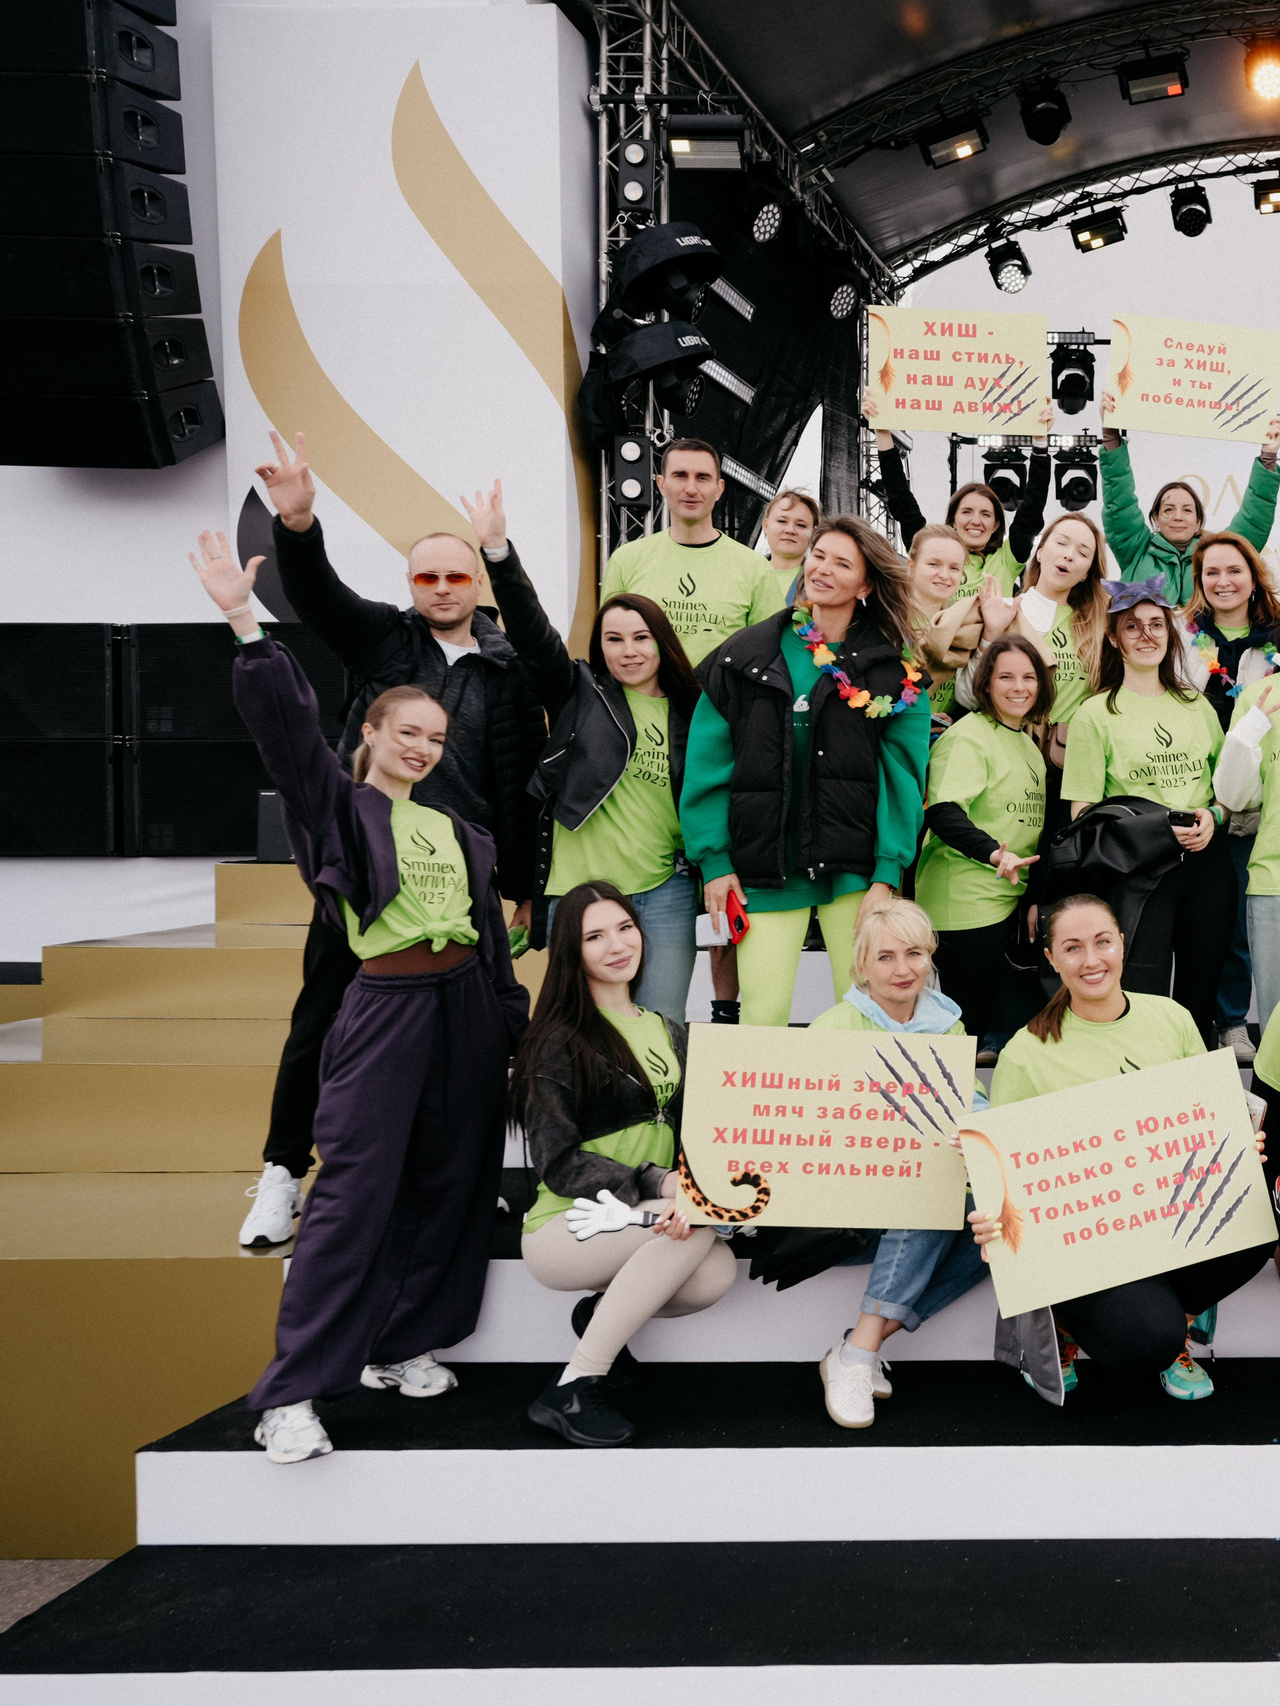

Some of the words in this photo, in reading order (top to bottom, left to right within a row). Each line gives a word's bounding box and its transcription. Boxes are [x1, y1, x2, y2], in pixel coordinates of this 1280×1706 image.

[923, 321, 978, 338] ХИШ
[1163, 337, 1227, 355] Следуй
[893, 348, 941, 361] наш
[951, 350, 1024, 368] стиль,
[1156, 357, 1176, 368] за
[1183, 358, 1231, 376] ХИШ,
[906, 373, 954, 387] наш
[964, 376, 1011, 391] дух,
[1172, 378, 1182, 387] и
[1190, 379, 1212, 390] ты
[895, 397, 942, 411] наш
[953, 400, 1023, 414] движ!
[1140, 393, 1241, 412] победишь!
[661, 597, 708, 611] Sminex
[664, 610, 727, 626] МПИАДА
[1054, 672, 1075, 682] 025
[1145, 751, 1189, 764] Sminex
[633, 767, 669, 787] 2025
[1128, 758, 1206, 781] ОЛИМПИАД
[1160, 777, 1187, 788] 2025
[1024, 788, 1044, 802] Smine
[1027, 816, 1043, 828] 202
[400, 856, 457, 874] Sminex
[418, 891, 446, 905] 025
[721, 1070, 841, 1092] ХИШный
[853, 1080, 939, 1098] зверь,
[752, 1103, 804, 1119] мяч
[816, 1103, 907, 1122] забей!
[711, 1126, 833, 1147] ХИШный
[844, 1135, 922, 1152] зверь
[1009, 1135, 1103, 1170] Только
[1113, 1128, 1127, 1142] с
[1135, 1102, 1216, 1137] Юлей,
[727, 1159, 790, 1174] всех
[801, 1160, 923, 1178] сильней!
[1022, 1161, 1113, 1196] только
[1124, 1154, 1137, 1169] с
[1146, 1129, 1216, 1163] ХИШ!
[1029, 1189, 1121, 1224] Только
[1132, 1182, 1146, 1196] с
[1156, 1161, 1223, 1190] нами
[1062, 1191, 1206, 1246] победишь!
